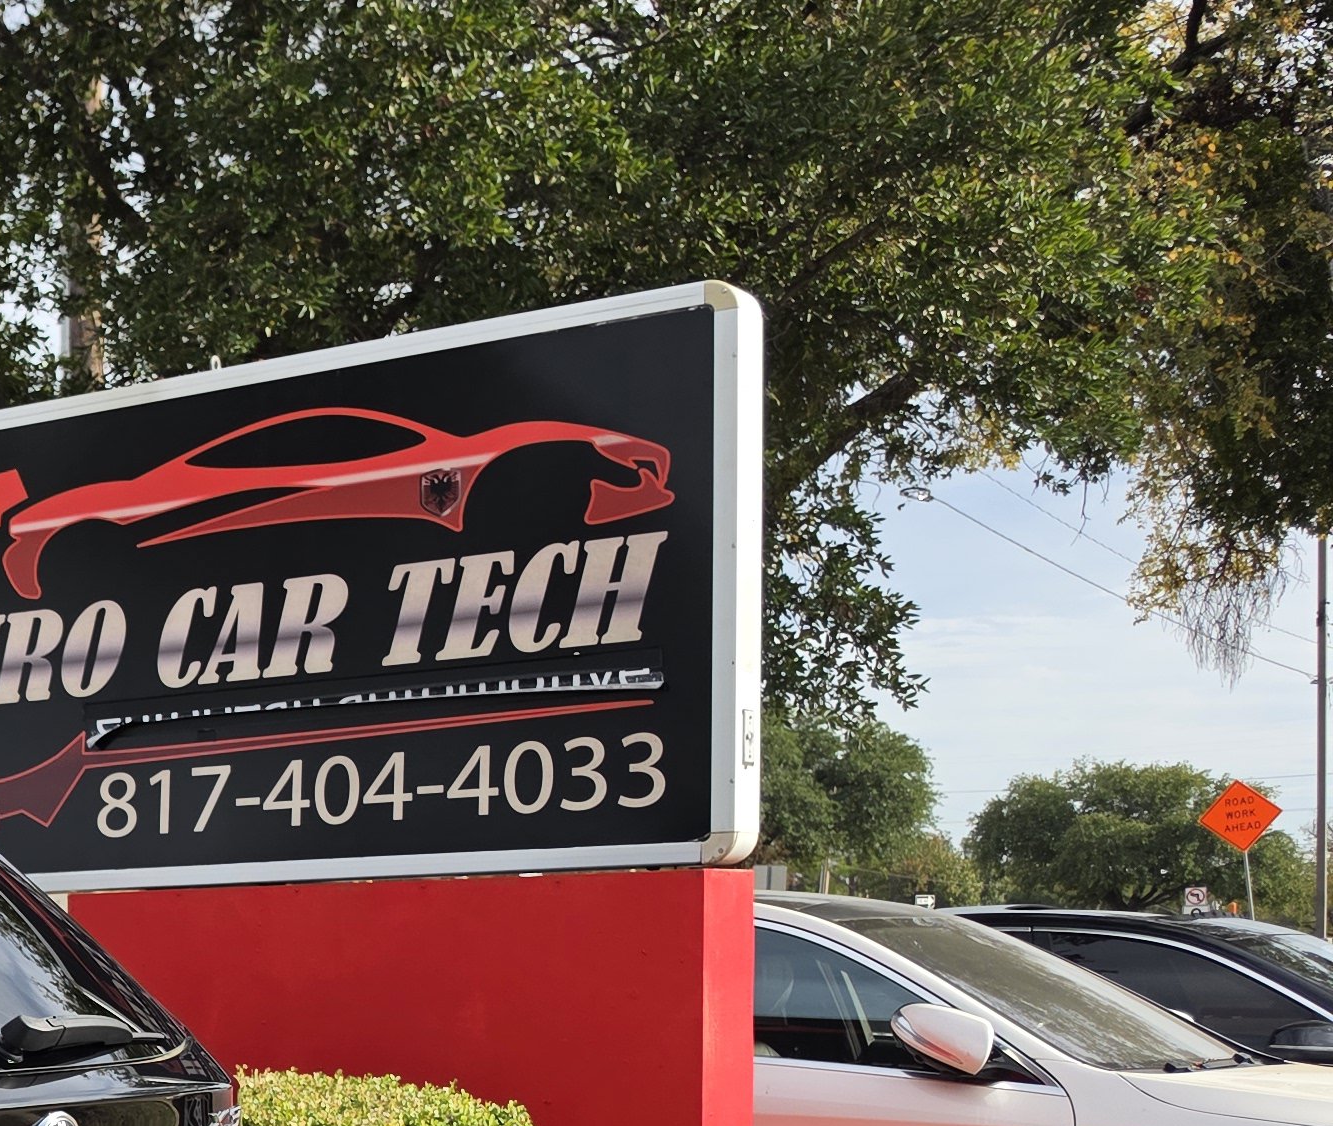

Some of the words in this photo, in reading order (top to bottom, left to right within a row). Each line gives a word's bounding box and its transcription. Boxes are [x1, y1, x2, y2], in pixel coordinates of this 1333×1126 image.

[157, 573, 350, 688] CAR
[381, 531, 669, 667] TECH
[96, 731, 666, 839] 817-404-4033
[1224, 796, 1254, 807] ROAD
[1225, 809, 1256, 820] WORK
[1224, 821, 1261, 832] AHEAD
